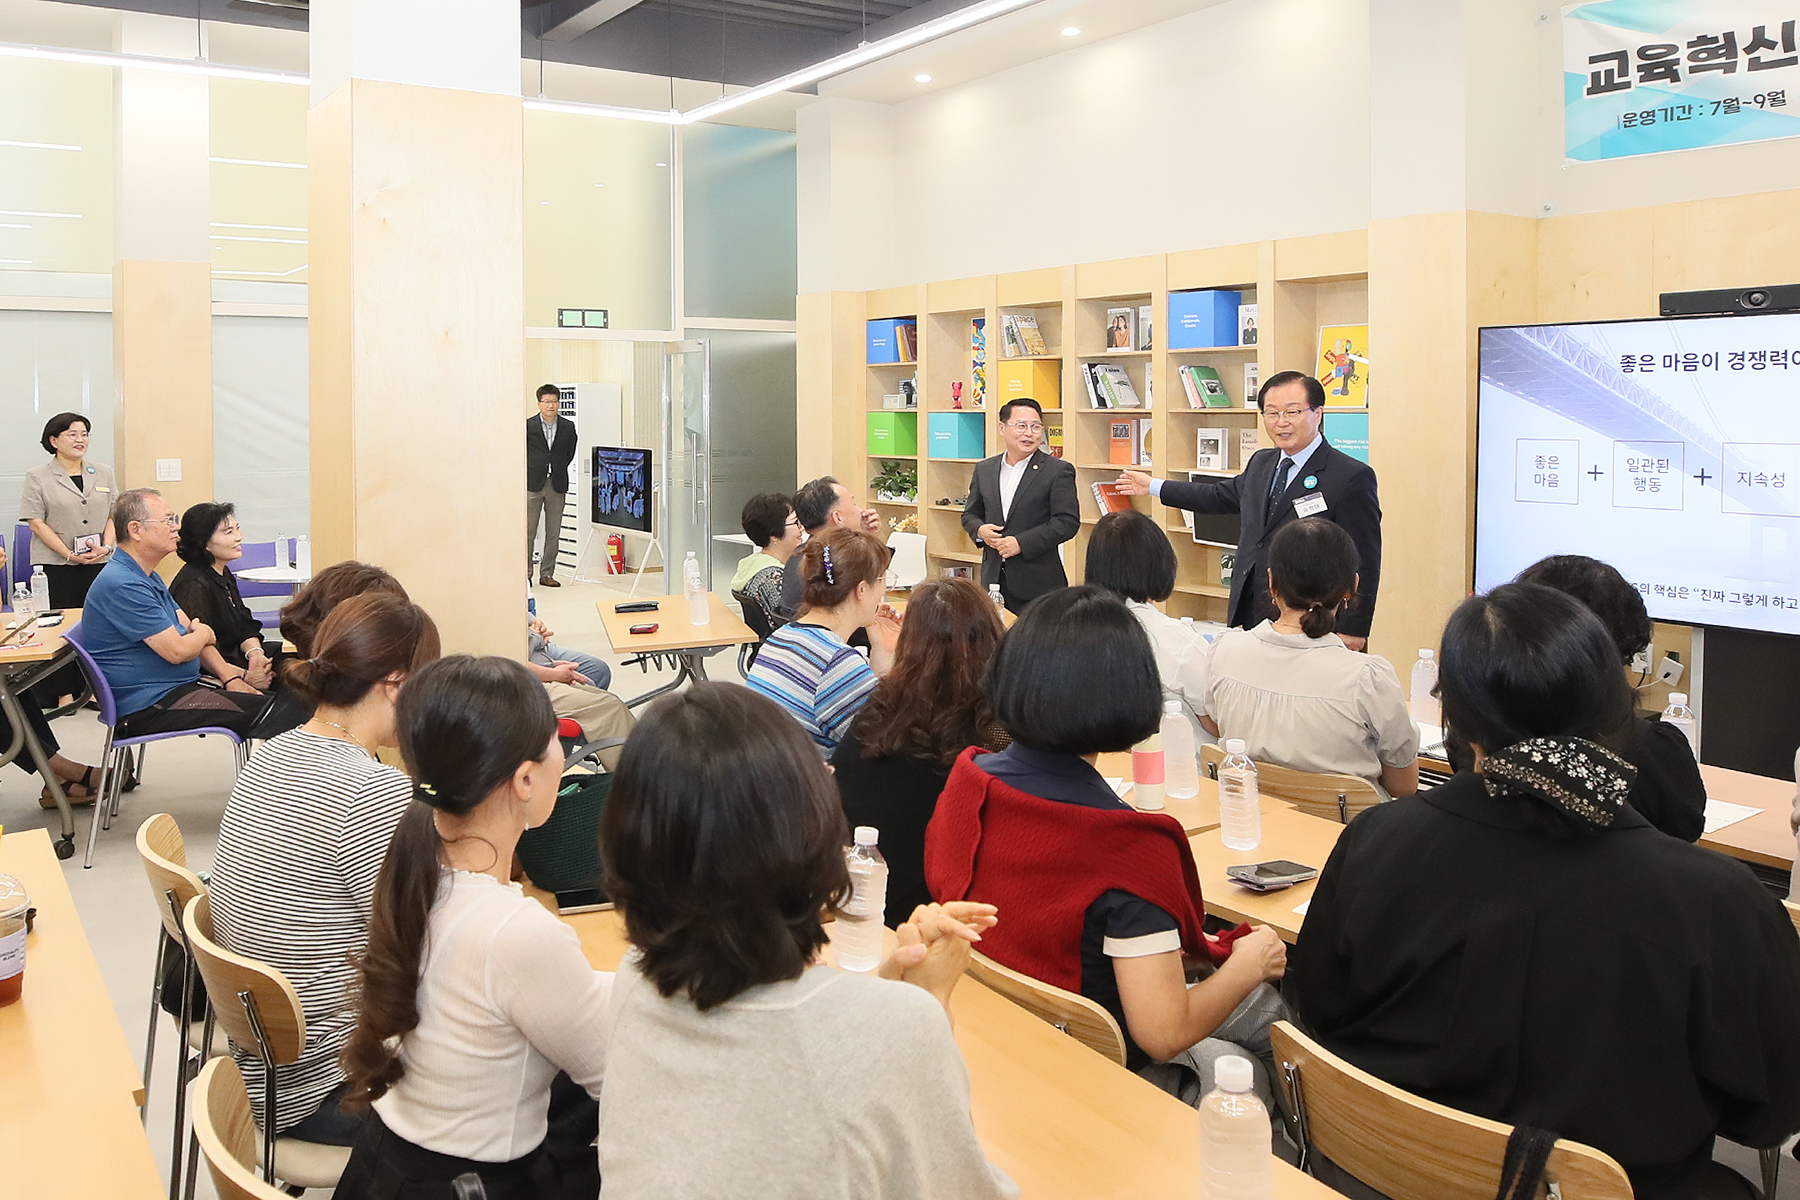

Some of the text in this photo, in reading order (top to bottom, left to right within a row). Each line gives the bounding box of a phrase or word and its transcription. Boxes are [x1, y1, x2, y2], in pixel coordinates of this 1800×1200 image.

[1586, 20, 1798, 95] 교육혁신
[1622, 104, 1693, 128] 운영기간
[1710, 89, 1787, 116] 7월~9월
[1620, 354, 1656, 373] 좋은
[1663, 351, 1719, 372] 마음이
[1534, 454, 1560, 469] 좋은
[1626, 458, 1669, 474] 일관된
[1534, 473, 1560, 488] 마음
[1633, 477, 1662, 493] 행동
[1737, 471, 1785, 489] 지속성
[1653, 584, 1690, 599] 핵심은
[1729, 592, 1768, 608] 그렇게
